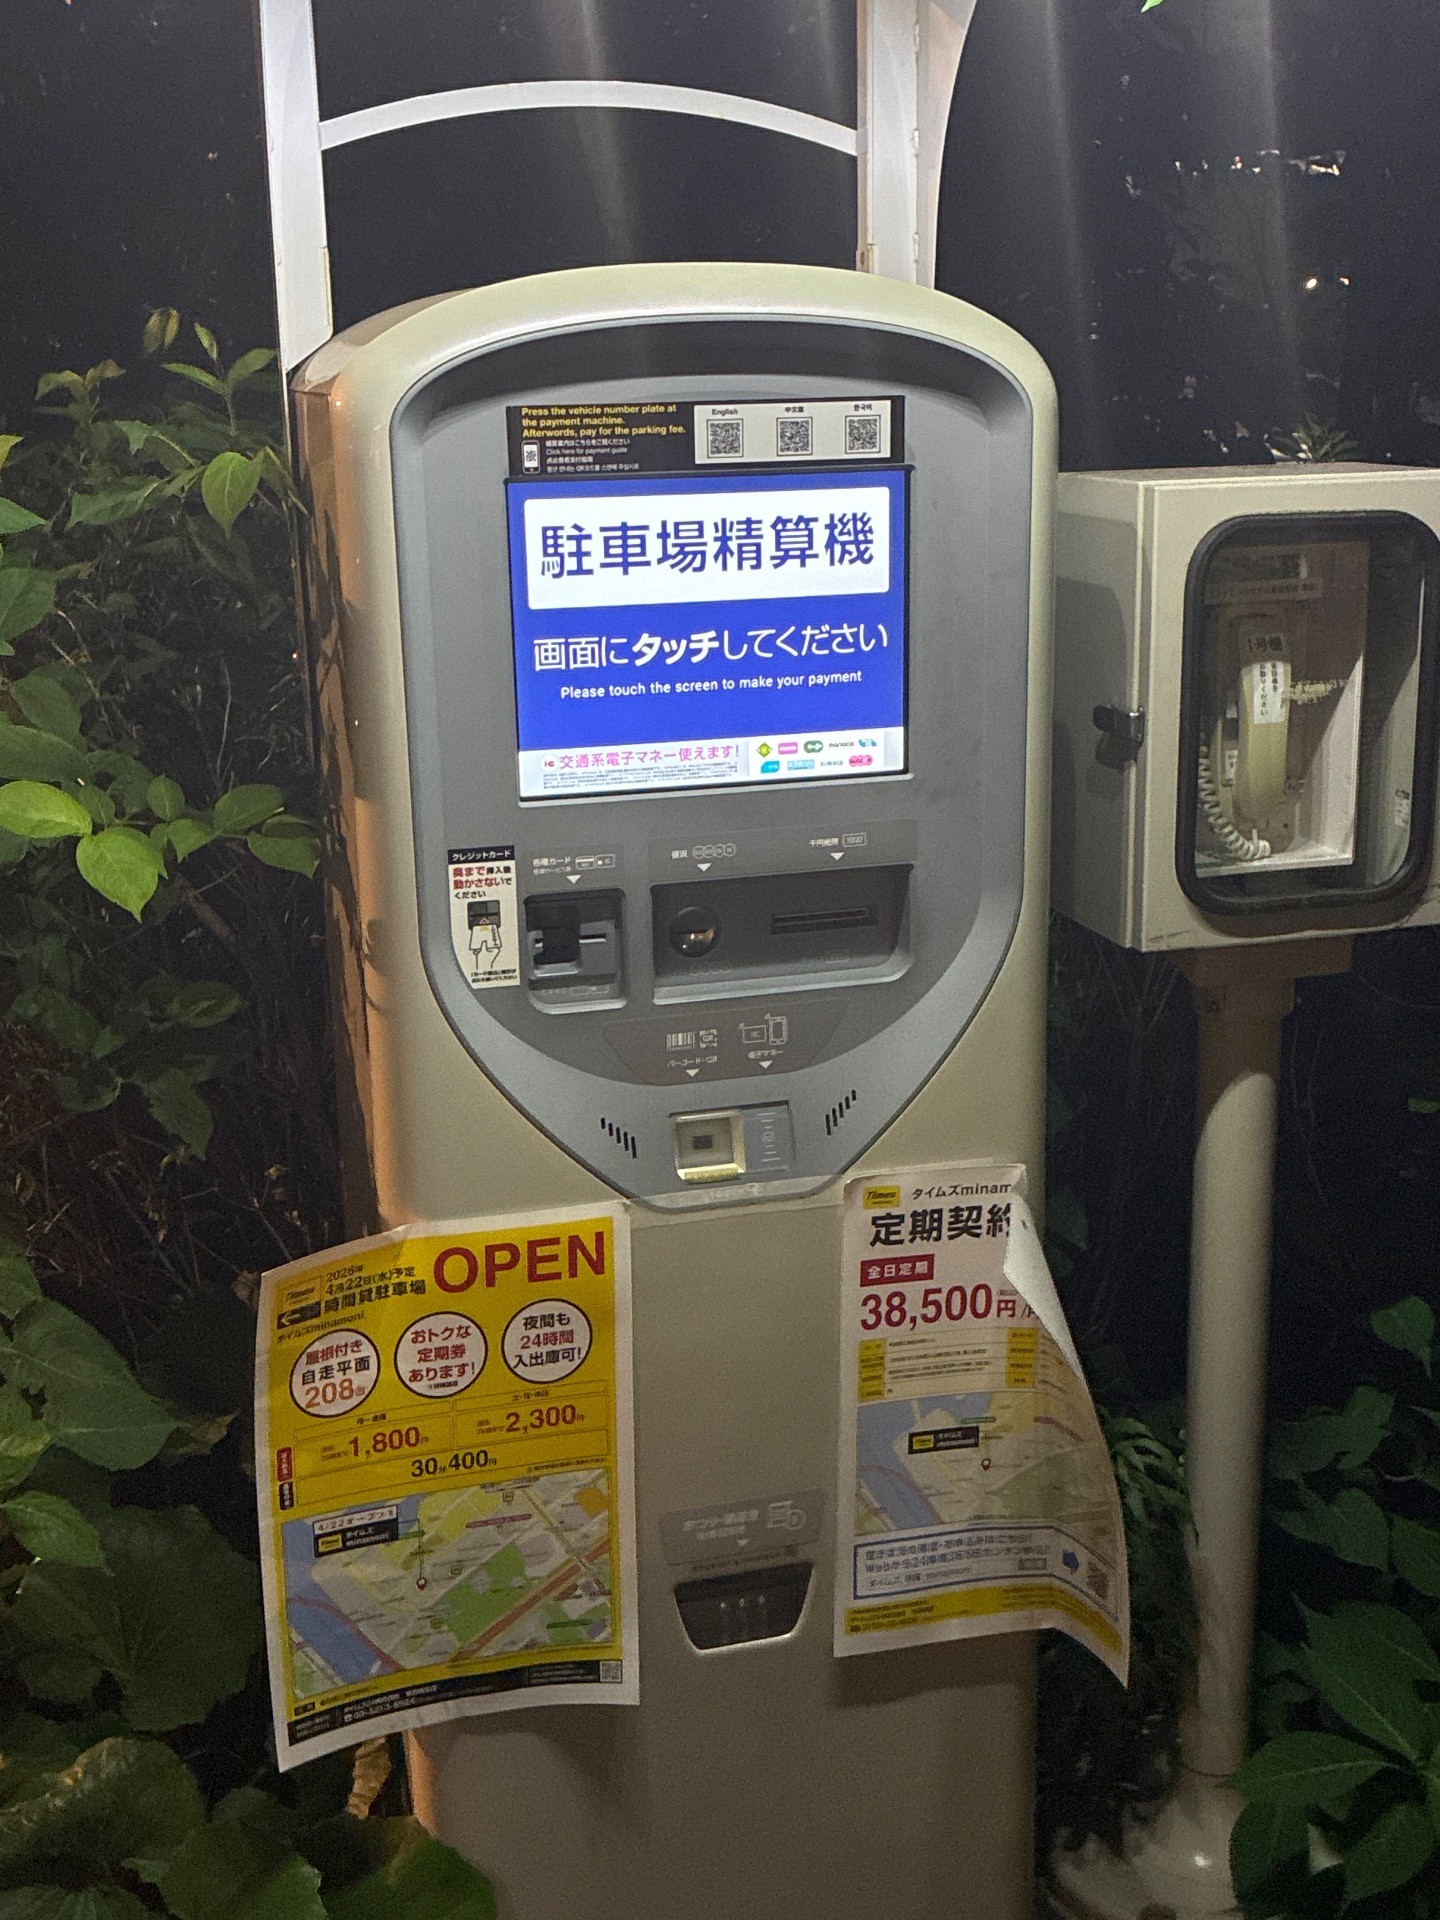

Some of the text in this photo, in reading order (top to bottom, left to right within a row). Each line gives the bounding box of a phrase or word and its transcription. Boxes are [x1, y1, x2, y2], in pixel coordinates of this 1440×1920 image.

[522, 404, 677, 416] Press the vehicle number plate at
[712, 407, 738, 417] English
[853, 403, 873, 412] 한국어
[522, 416, 625, 428] the payment machine.
[523, 424, 686, 439] Afterwords, pay for the parking fee.
[585, 446, 610, 456] payment
[540, 511, 875, 579] 駐車場精算機
[533, 623, 889, 672] 画面にタッチしてください
[560, 670, 862, 699] Please touch the screen to make your payment
[560, 745, 739, 769] 交通系電子マネー使えます!
[452, 850, 511, 862] クレジットカード
[453, 878, 512, 890] 動かさないで
[455, 891, 487, 899] ください
[433, 1230, 606, 1294] OPEN
[867, 1261, 928, 1280] 全日定期
[325, 1279, 426, 1313] 時間貸駐車場
[522, 1312, 571, 1332] 夜間も
[410, 1324, 471, 1345] おトクな
[519, 1329, 575, 1350] 24時間
[305, 1340, 362, 1365] 屋根付き
[417, 1344, 466, 1364] 定期券
[513, 1346, 582, 1370] 入出庫可!
[301, 1356, 371, 1386] 自走平面
[408, 1363, 476, 1385] あります!
